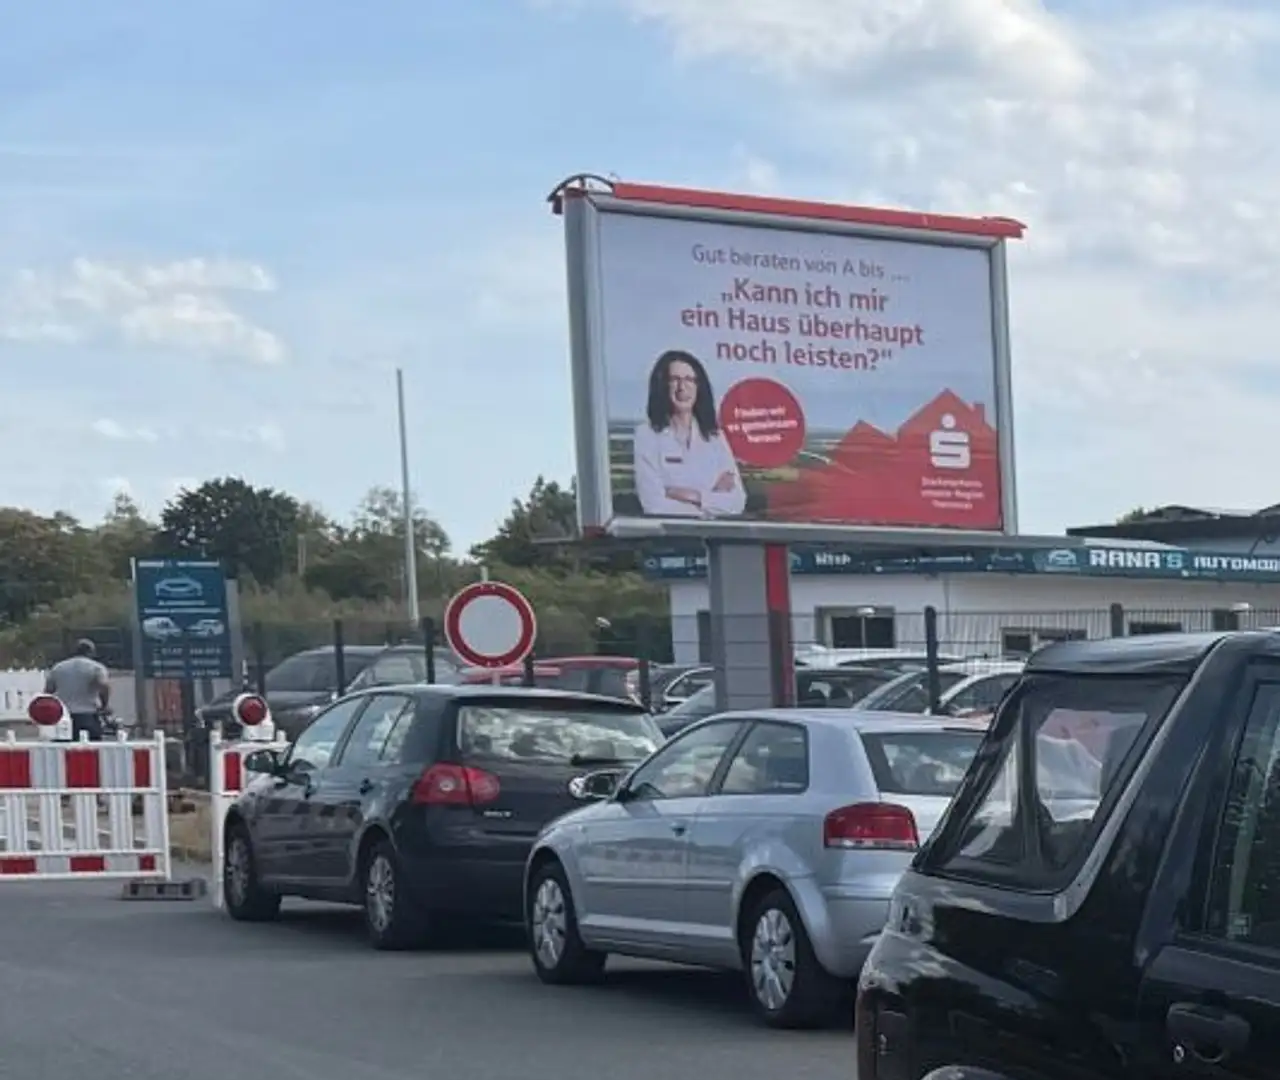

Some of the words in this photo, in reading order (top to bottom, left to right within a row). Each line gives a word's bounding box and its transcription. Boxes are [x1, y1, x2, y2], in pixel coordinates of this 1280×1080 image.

[691, 244, 725, 264] Gut
[729, 247, 801, 271] beraten
[804, 259, 837, 275] von
[842, 259, 856, 275] A
[858, 261, 885, 279] bis
[720, 277, 798, 305] „Kann
[804, 282, 841, 309] ich
[848, 287, 890, 312] mir
[681, 303, 719, 328] ein
[728, 307, 791, 333] Haus
[798, 312, 925, 348] überhaupt
[715, 339, 778, 363] noch
[1088, 549, 1183, 569] RANA'S
